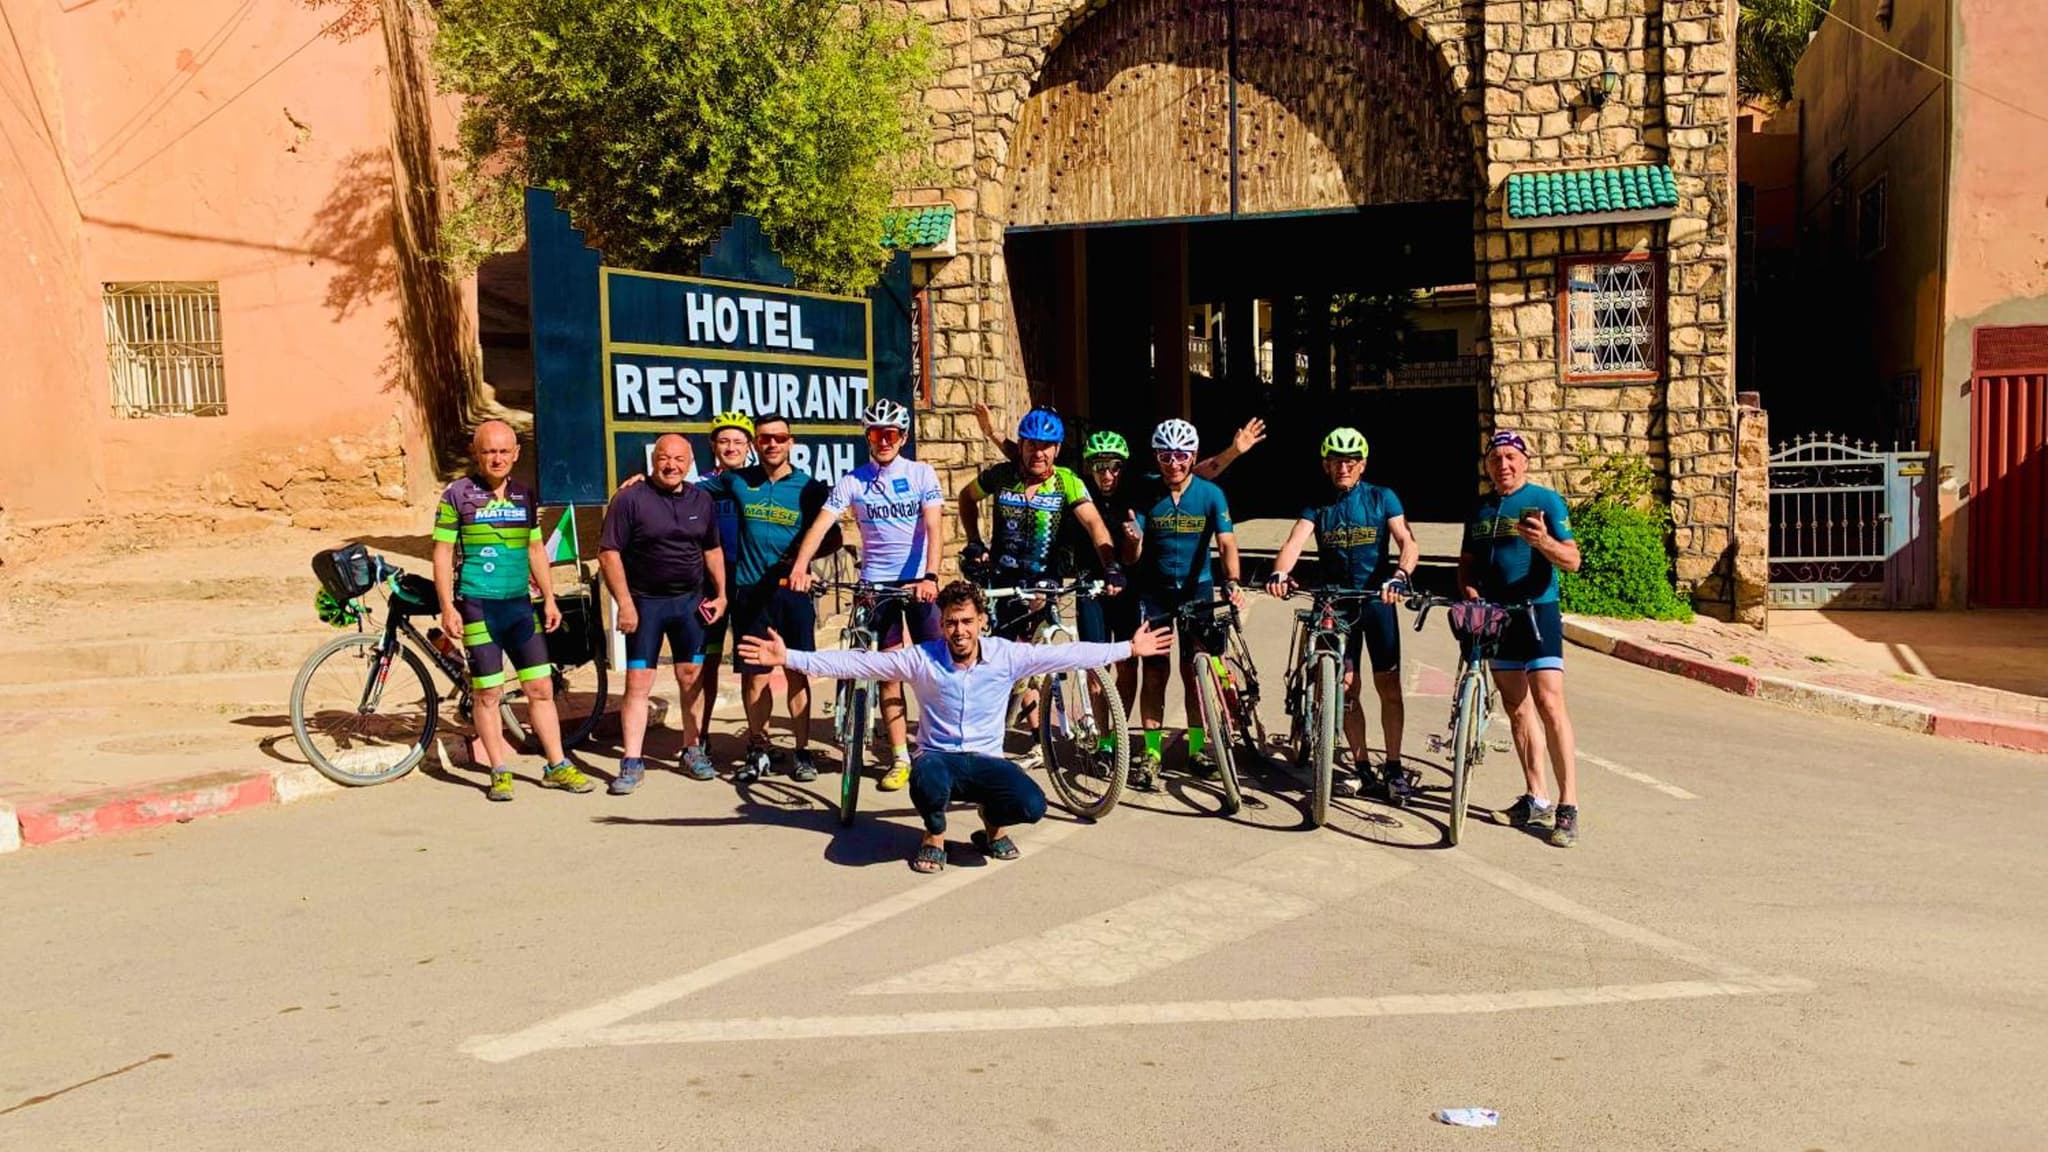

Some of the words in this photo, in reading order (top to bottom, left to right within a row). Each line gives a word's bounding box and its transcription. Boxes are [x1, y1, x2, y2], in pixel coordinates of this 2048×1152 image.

[686, 291, 814, 350] HOTEL
[615, 363, 868, 420] RESTAURANT
[474, 507, 528, 519] MATESE
